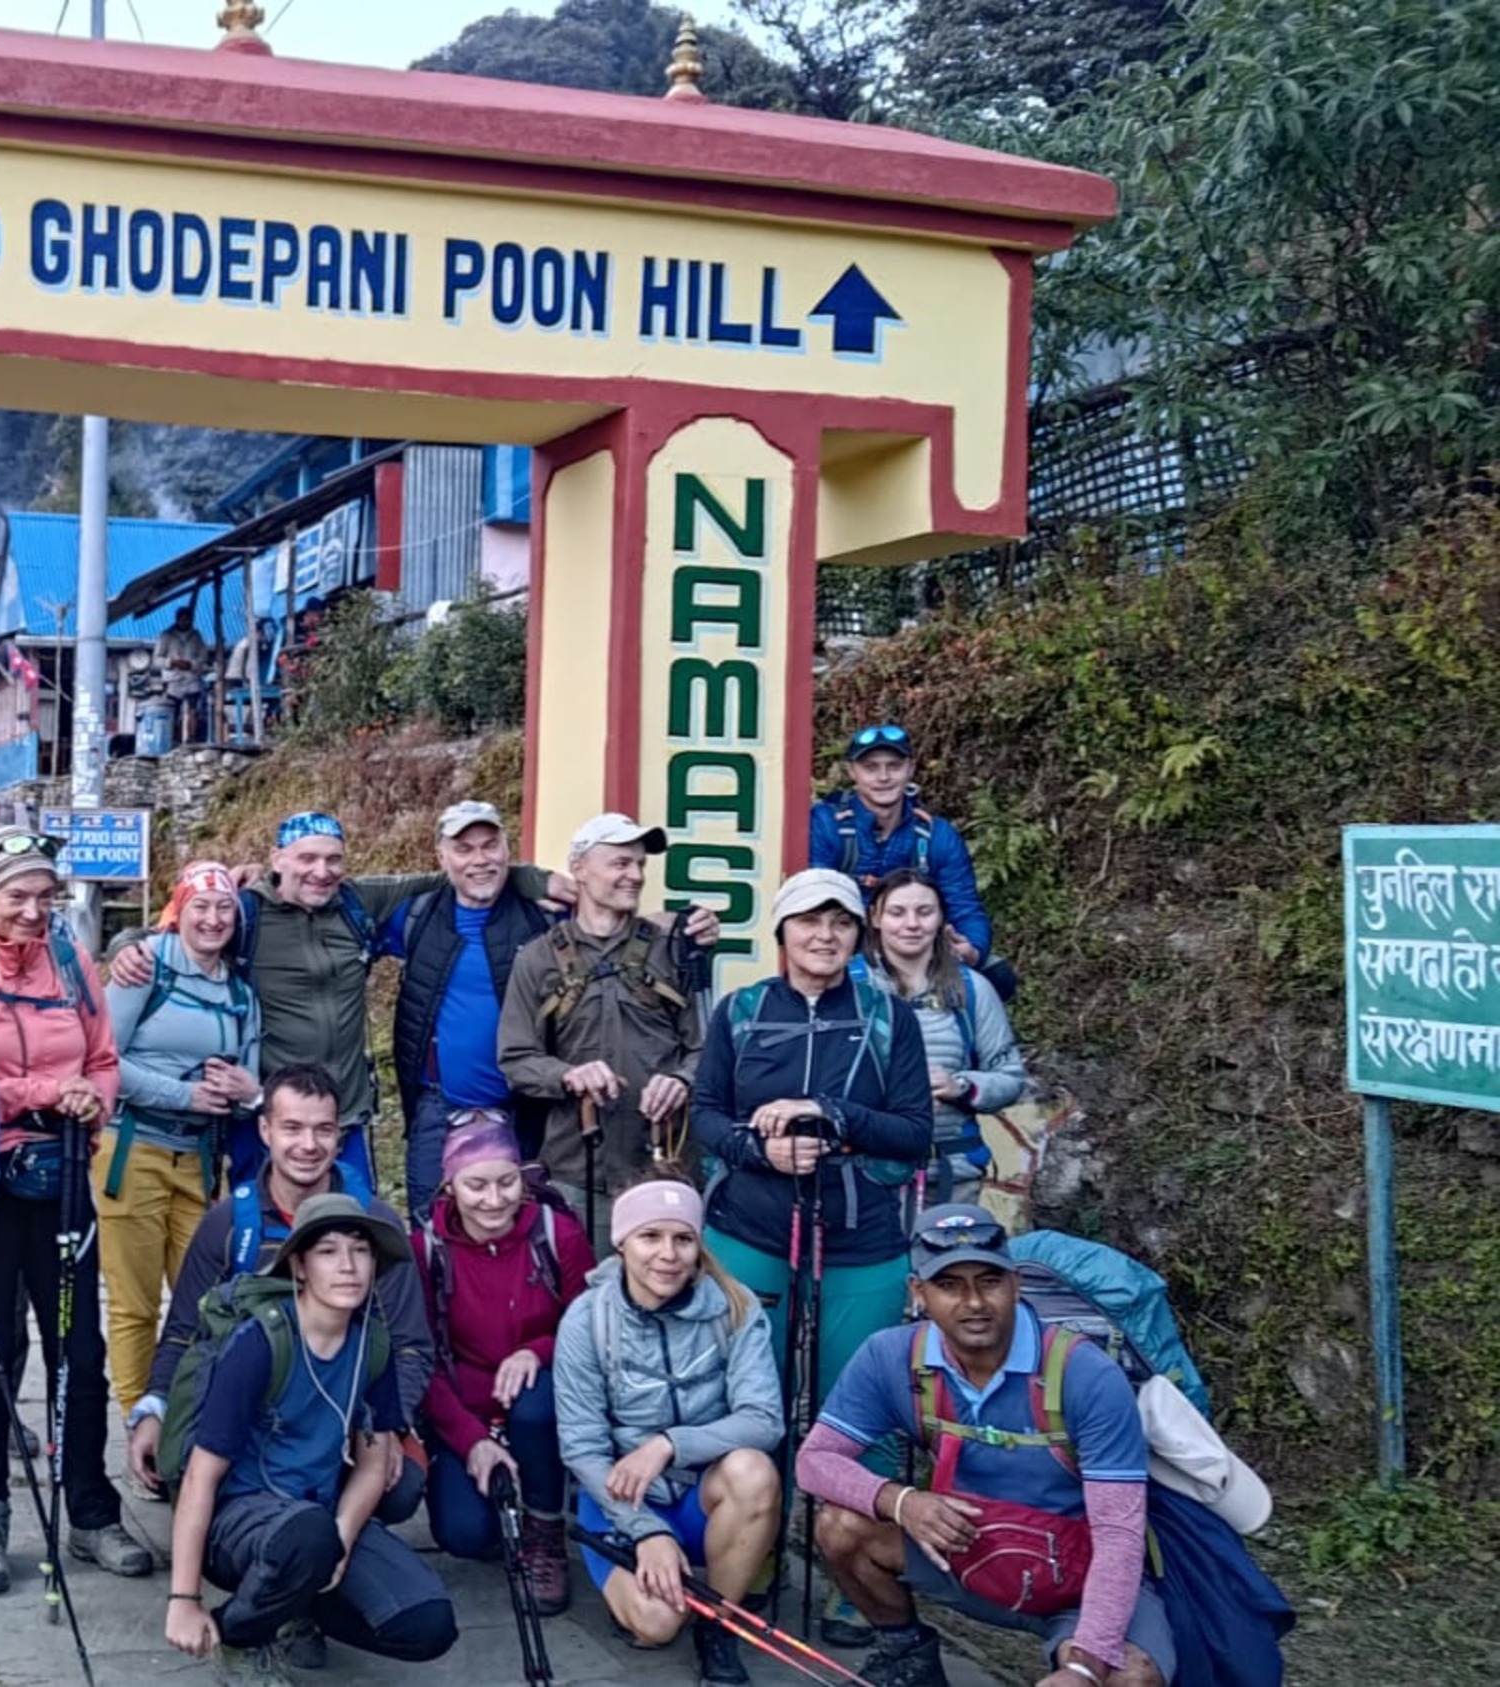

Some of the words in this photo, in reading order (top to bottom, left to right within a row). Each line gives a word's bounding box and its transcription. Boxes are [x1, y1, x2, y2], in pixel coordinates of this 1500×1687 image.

[30, 200, 408, 316] GHODEPANI
[444, 239, 608, 333] POON
[640, 257, 802, 348] HILL
[99, 847, 139, 863] POINT
